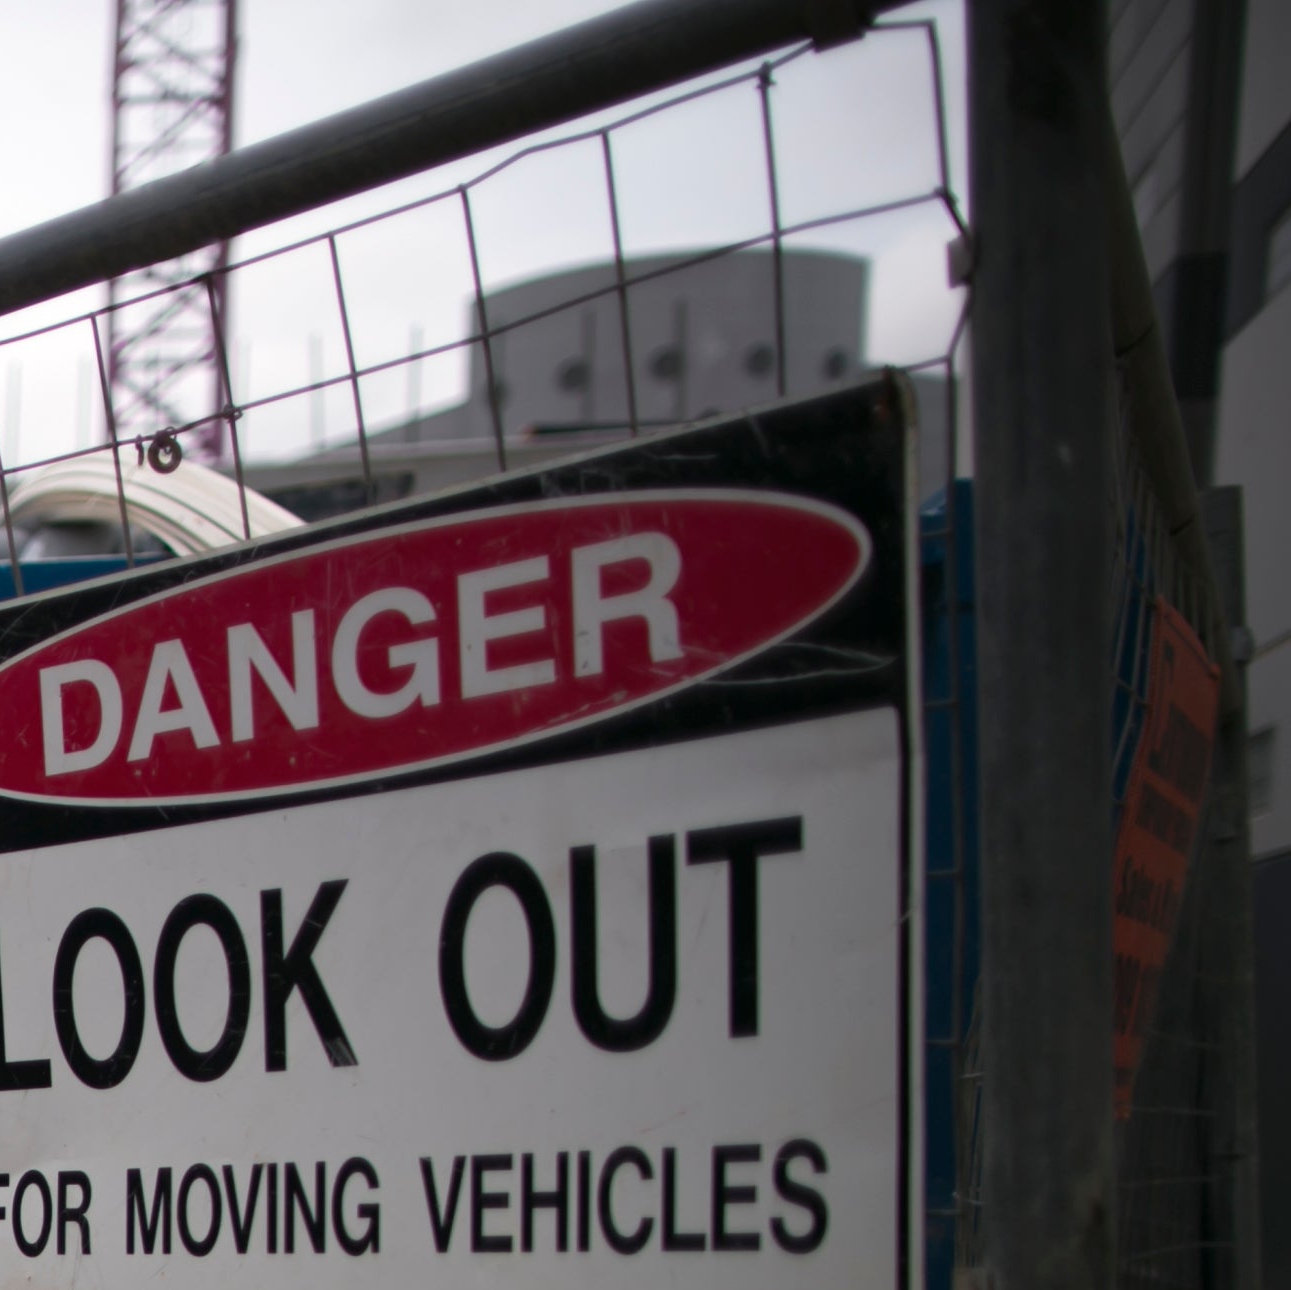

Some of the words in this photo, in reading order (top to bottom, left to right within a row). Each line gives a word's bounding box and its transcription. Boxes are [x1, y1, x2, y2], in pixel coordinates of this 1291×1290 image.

[39, 530, 685, 776] DANGER
[438, 815, 803, 1062] OUT
[125, 1157, 381, 1257] MOVING
[420, 1138, 829, 1256] VEHICLES
